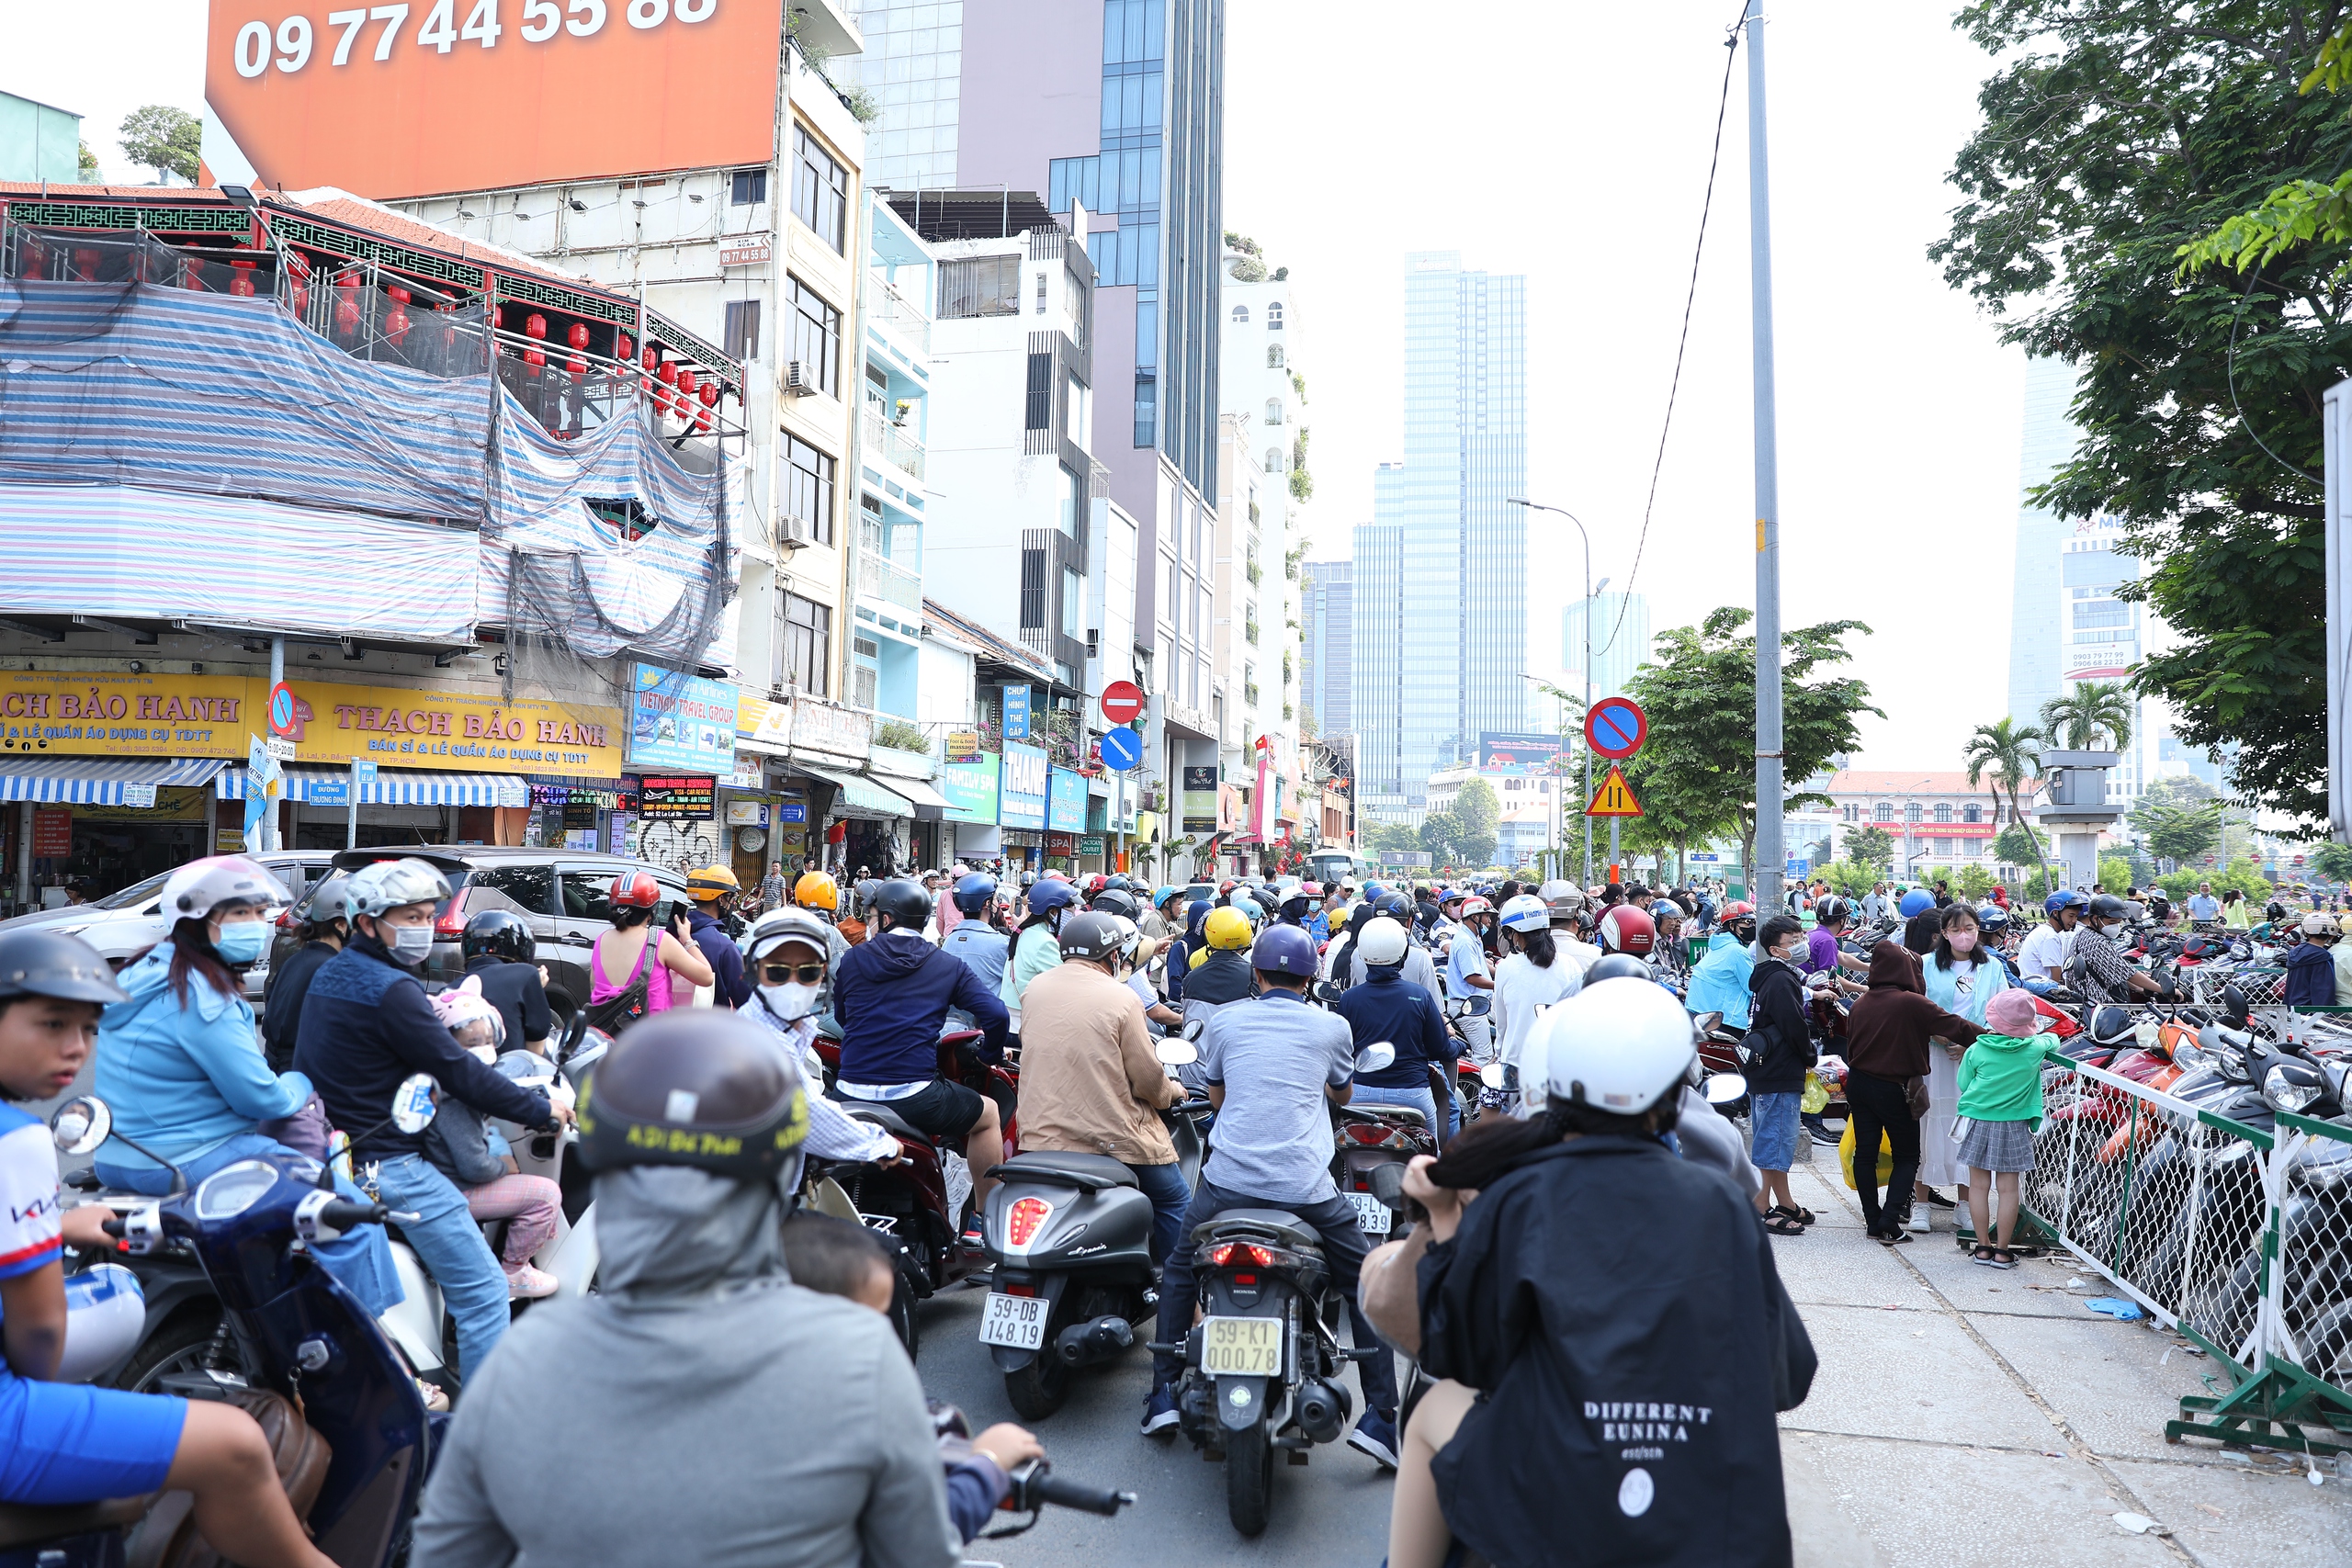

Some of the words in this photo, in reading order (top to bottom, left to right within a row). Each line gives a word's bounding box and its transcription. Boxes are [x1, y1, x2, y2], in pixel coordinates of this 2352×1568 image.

[234, 15, 313, 78] 09
[328, 3, 409, 66] 77
[417, 0, 501, 54] 44
[520, 0, 607, 42] 55
[722, 252, 729, 263] 09
[732, 251, 739, 261] 77
[741, 251, 749, 260] 44
[751, 249, 758, 260] 55
[760, 248, 768, 259] 88
[700, 682, 727, 700] Airlines
[1007, 687, 1026, 698] CHỤP
[0, 693, 50, 718] CH
[57, 686, 127, 720] BẢO
[136, 695, 240, 726] HẠNH
[639, 691, 676, 713] VIETNAM
[679, 699, 706, 719] TRAVEL
[709, 705, 734, 724] GROUP
[1008, 699, 1025, 709] HÌNH
[334, 705, 453, 736] THẠCH
[464, 709, 526, 741] BẢO
[1010, 711, 1023, 722] THẺ
[23, 723, 40, 738] LẺ
[44, 724, 82, 740] QUẦN
[85, 725, 105, 739] ÁO
[110, 729, 147, 743] DỤNG
[151, 729, 169, 743] CỤ
[175, 730, 213, 742] TDTT
[1009, 725, 1023, 736] GẤP
[369, 738, 397, 752] BÁN
[419, 743, 428, 754] &
[432, 740, 448, 754] LẺ
[452, 742, 486, 758] QUẦN
[489, 745, 507, 758] ÁO
[511, 748, 542, 762] DỤNG
[546, 751, 560, 765] CỤ
[564, 752, 589, 764] TDTT
[614, 779, 640, 791] Center
[946, 768, 979, 789] FAMILY
[980, 774, 995, 792] SPA
[1006, 751, 1047, 796] THANH
[158, 798, 181, 810] CHÈ
[1051, 839, 1069, 847] SPA
[994, 1298, 1039, 1322] 59-DB
[989, 1319, 1039, 1345] 148.19
[1216, 1321, 1267, 1344] 59-K1
[1208, 1347, 1277, 1370] 000.78
[1583, 1401, 1713, 1424] DIFFERENT
[1603, 1423, 1689, 1442] EUNINA
